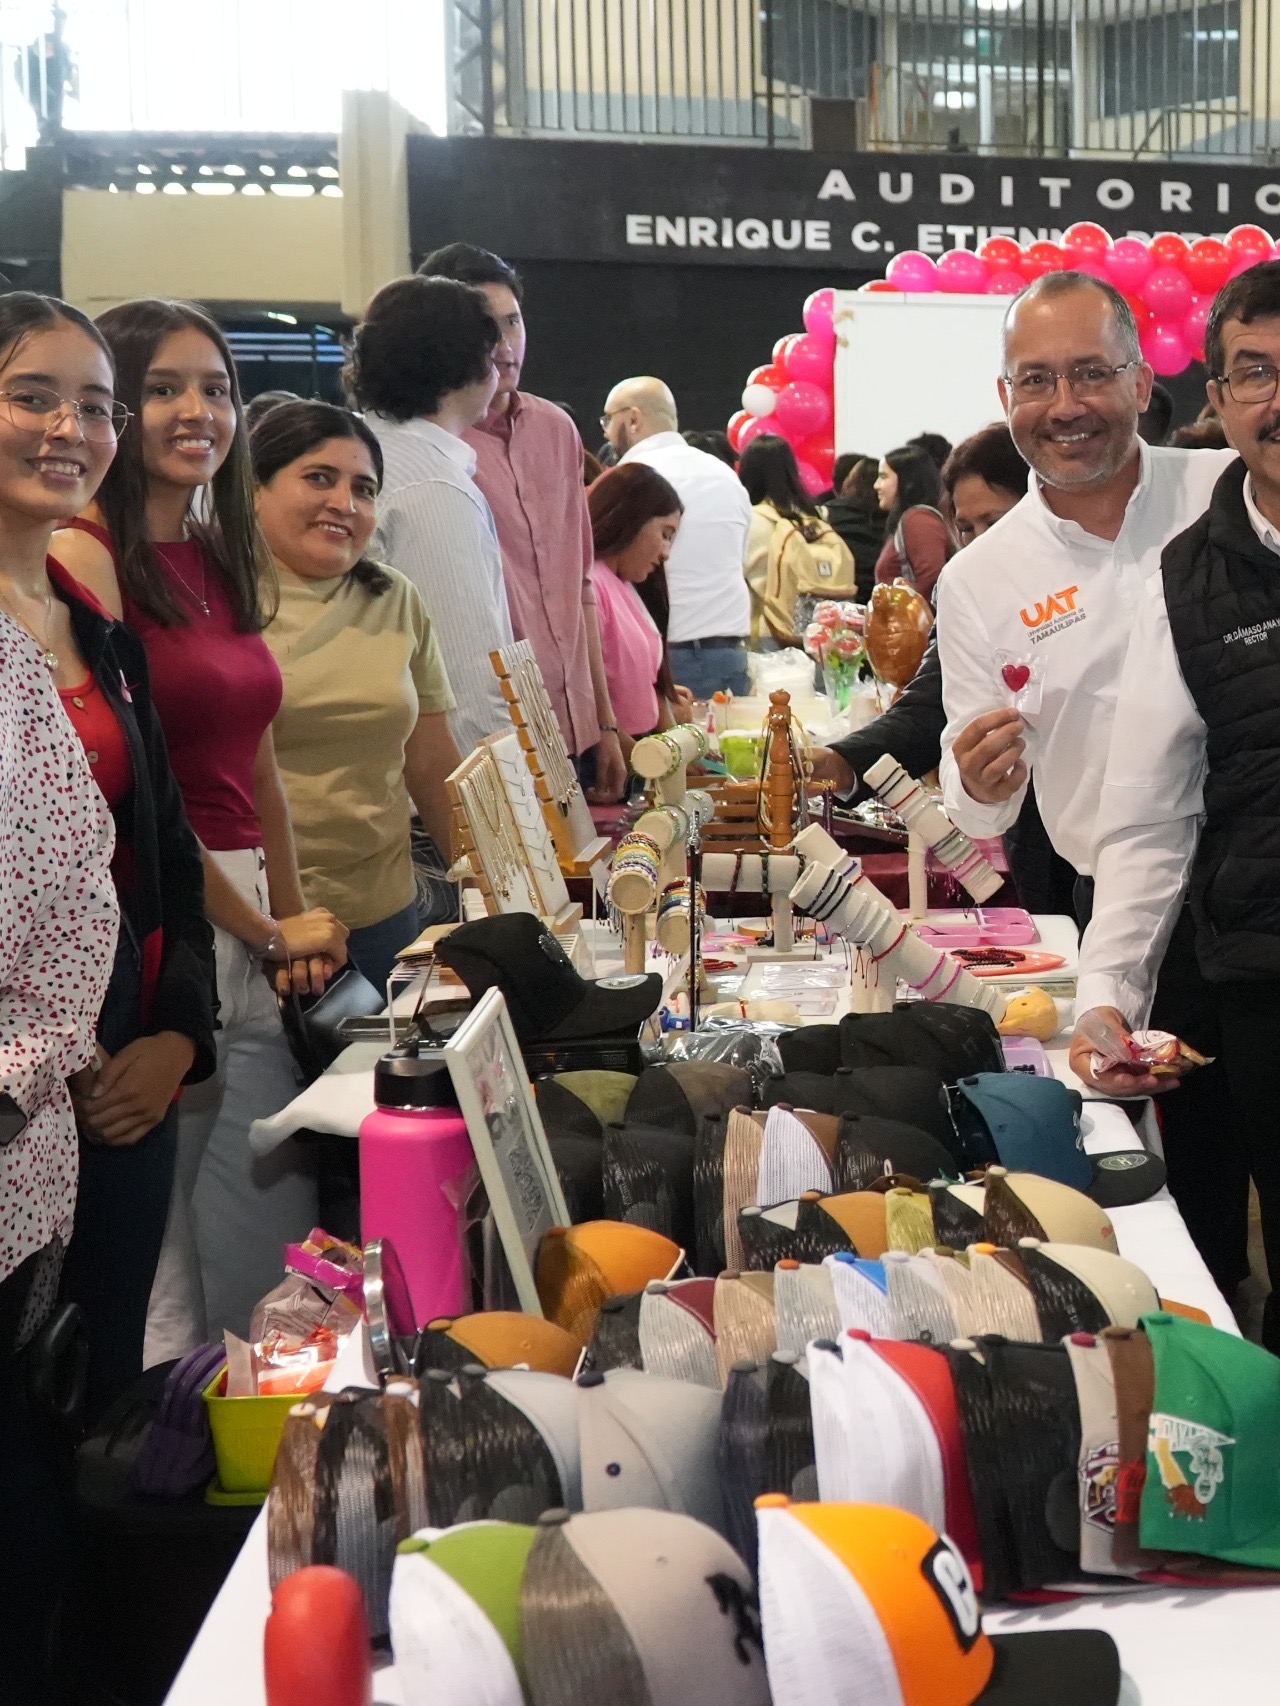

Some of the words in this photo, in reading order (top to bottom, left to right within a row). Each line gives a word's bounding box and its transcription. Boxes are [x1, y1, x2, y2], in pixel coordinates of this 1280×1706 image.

[625, 213, 832, 250] ENRIQUE
[850, 221, 895, 253] C.
[1019, 585, 1079, 628] UAT
[1030, 613, 1086, 645] TAMAULIPAS
[1244, 631, 1268, 646] RECTOR
